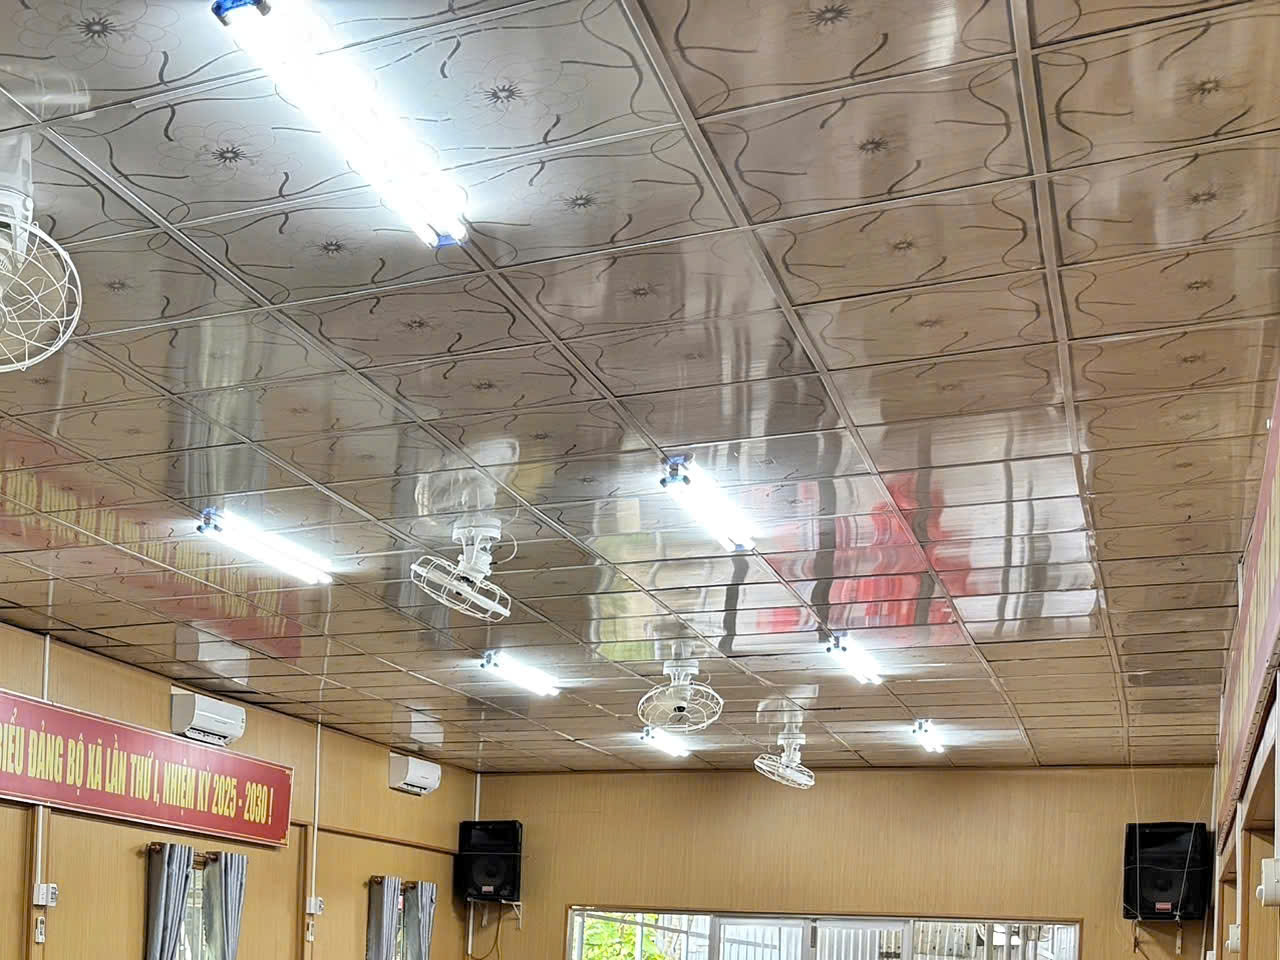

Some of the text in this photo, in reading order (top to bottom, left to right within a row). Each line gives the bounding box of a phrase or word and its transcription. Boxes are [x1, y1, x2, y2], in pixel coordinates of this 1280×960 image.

[27, 719, 65, 785] ĐẢNG
[66, 732, 84, 796] BỘ
[86, 738, 102, 791] XÃ
[104, 733, 128, 796] LẦN
[129, 750, 155, 801] THỨ
[162, 758, 197, 817] NHIỆM
[196, 765, 213, 813] KỲ
[211, 773, 238, 819] 2025
[242, 780, 269, 825] 2030
[268, 787, 274, 825] !
